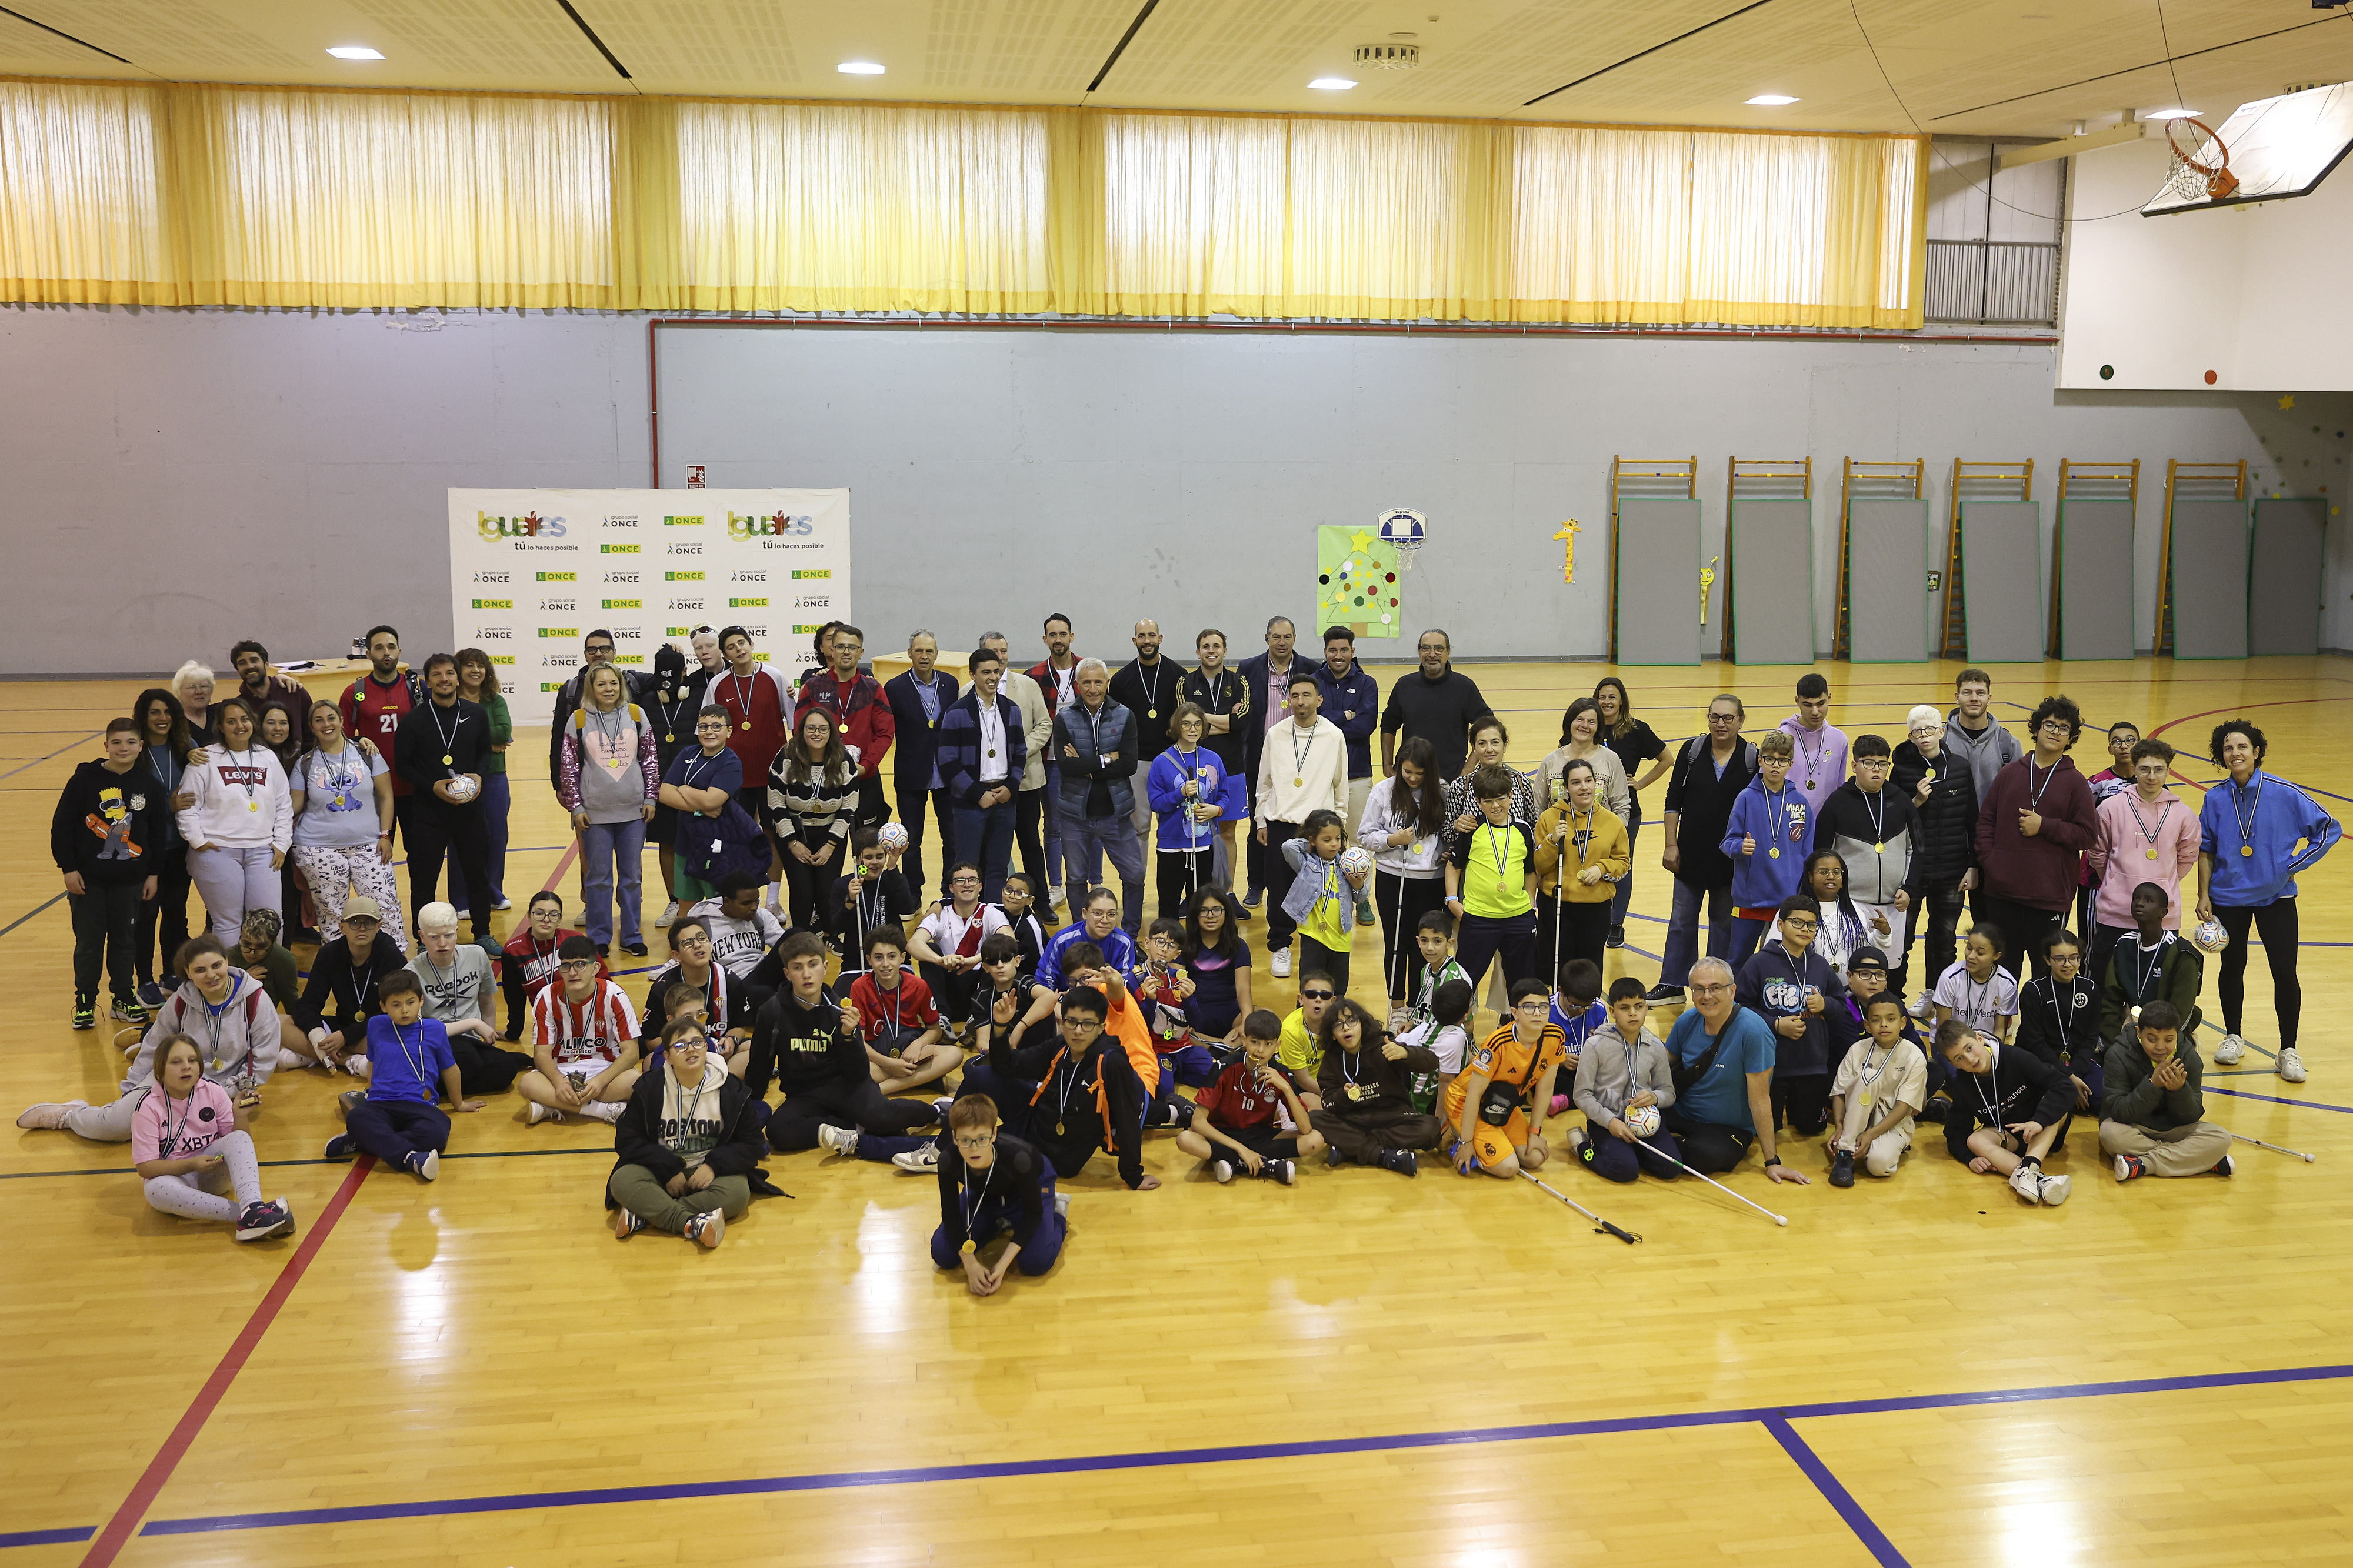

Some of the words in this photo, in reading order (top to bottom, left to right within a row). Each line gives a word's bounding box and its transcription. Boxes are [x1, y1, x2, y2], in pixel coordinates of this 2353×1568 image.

[515, 541, 526, 551] tú
[762, 540, 773, 549] tú
[379, 713, 398, 733] 21
[711, 934, 735, 962] NEW
[424, 976, 478, 995] Reebok
[790, 1038, 827, 1052] PUMA
[2007, 1085, 2028, 1103] HILFIGER
[1241, 1096, 1255, 1110] 10
